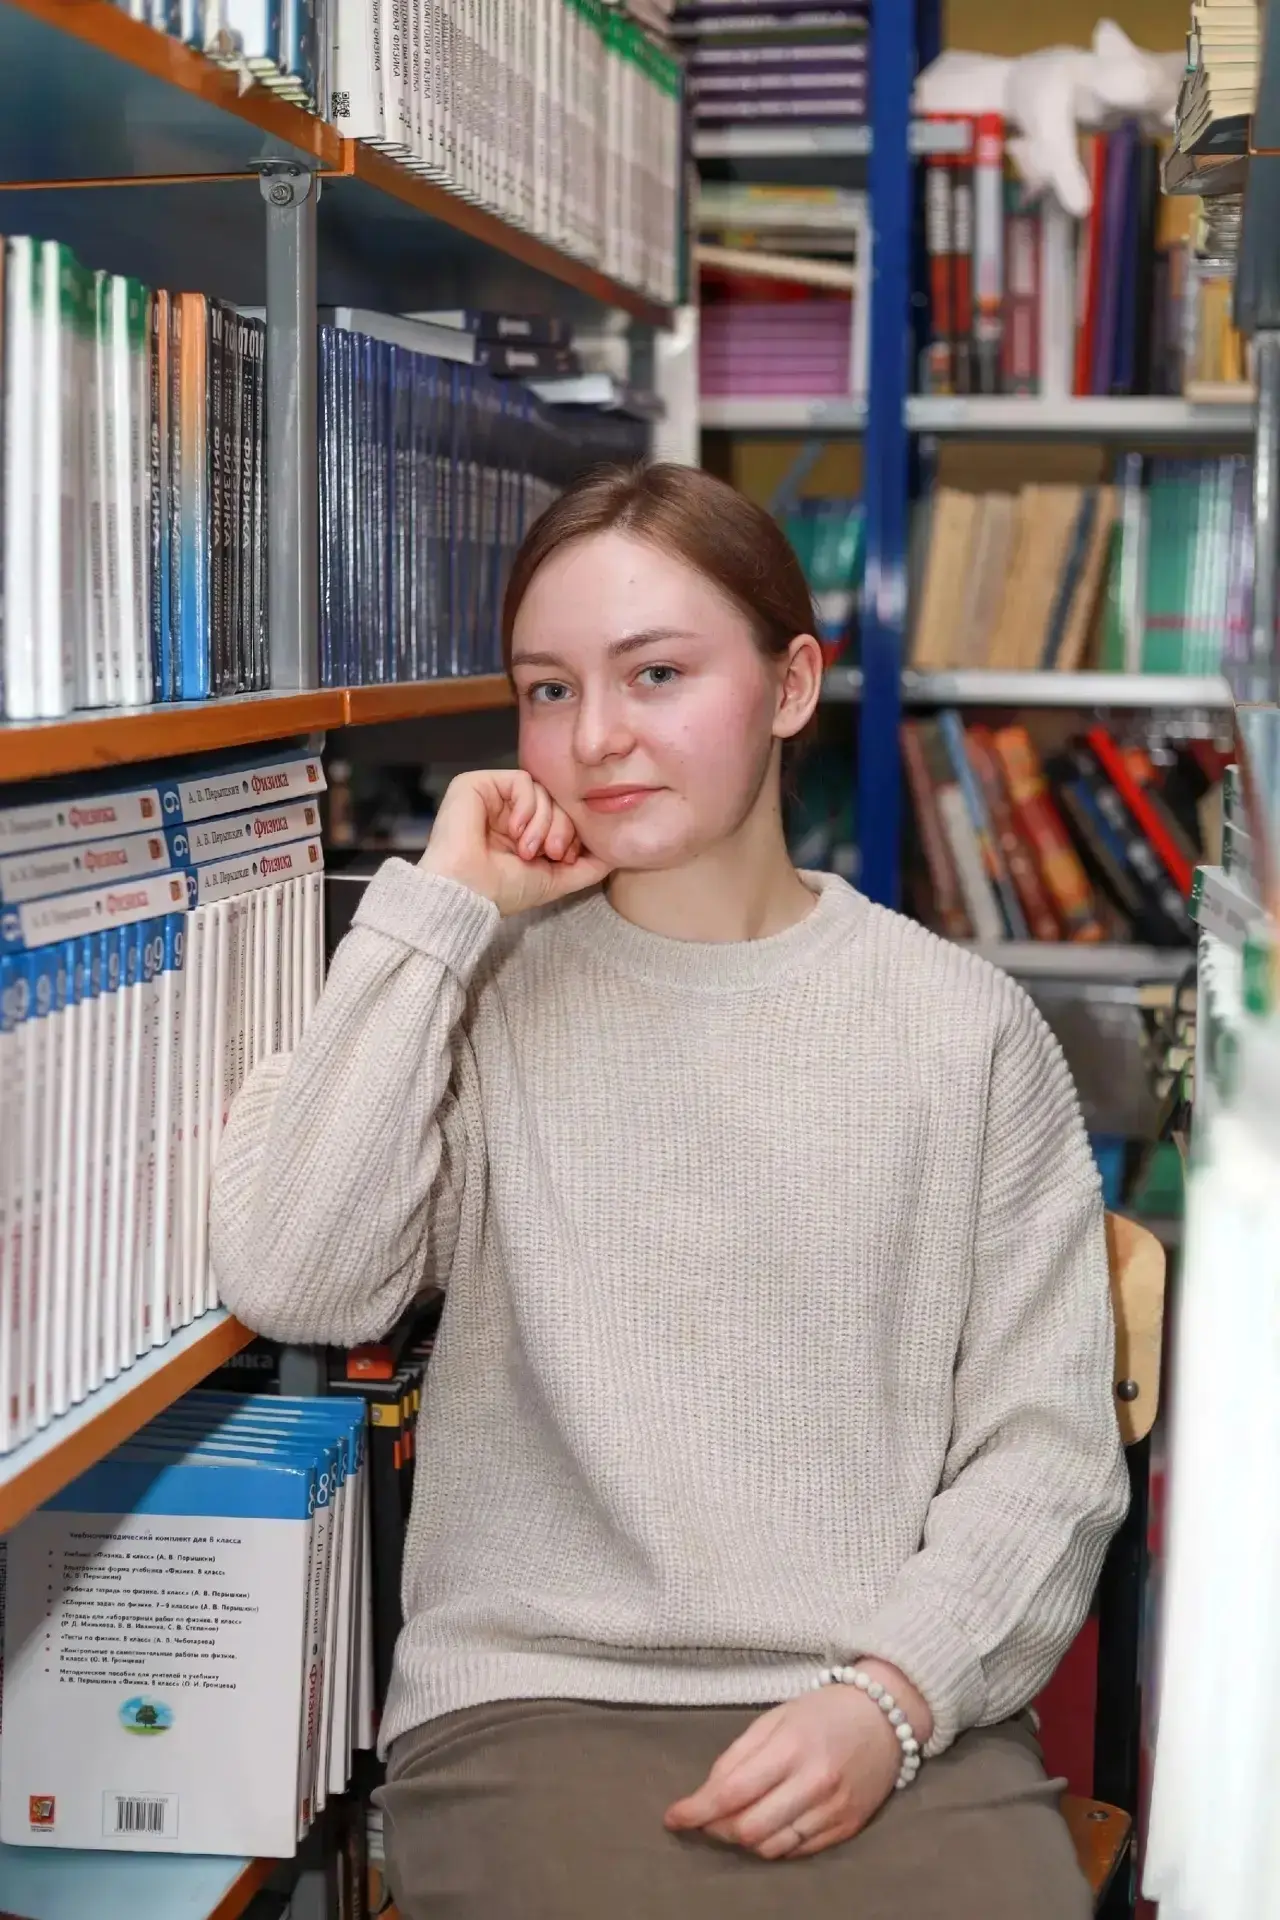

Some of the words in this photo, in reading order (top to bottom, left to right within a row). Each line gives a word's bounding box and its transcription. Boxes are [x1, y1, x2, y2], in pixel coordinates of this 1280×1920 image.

[392, 34, 401, 77] ФИЗИКА
[423, 58, 431, 99] ФИЗИКА
[211, 307, 222, 340] 10
[224, 319, 234, 351] 10
[243, 327, 255, 358] 10
[151, 423, 160, 548] ФИЗИКА
[223, 433, 231, 547] ФИЗИКА
[243, 437, 251, 549] ФИЗИКА
[188, 792, 197, 804] А.
[205, 785, 240, 801] Перышкин
[251, 772, 289, 795] Физика
[196, 836, 204, 848] А.
[212, 828, 244, 845] Перышкин
[254, 816, 289, 838] Физика
[204, 875, 212, 888] А.
[259, 853, 292, 877] Физика
[153, 935, 164, 972] 9
[174, 932, 183, 967] 9
[317, 1473, 329, 1504] 8
[306, 1663, 318, 1751] Физика
